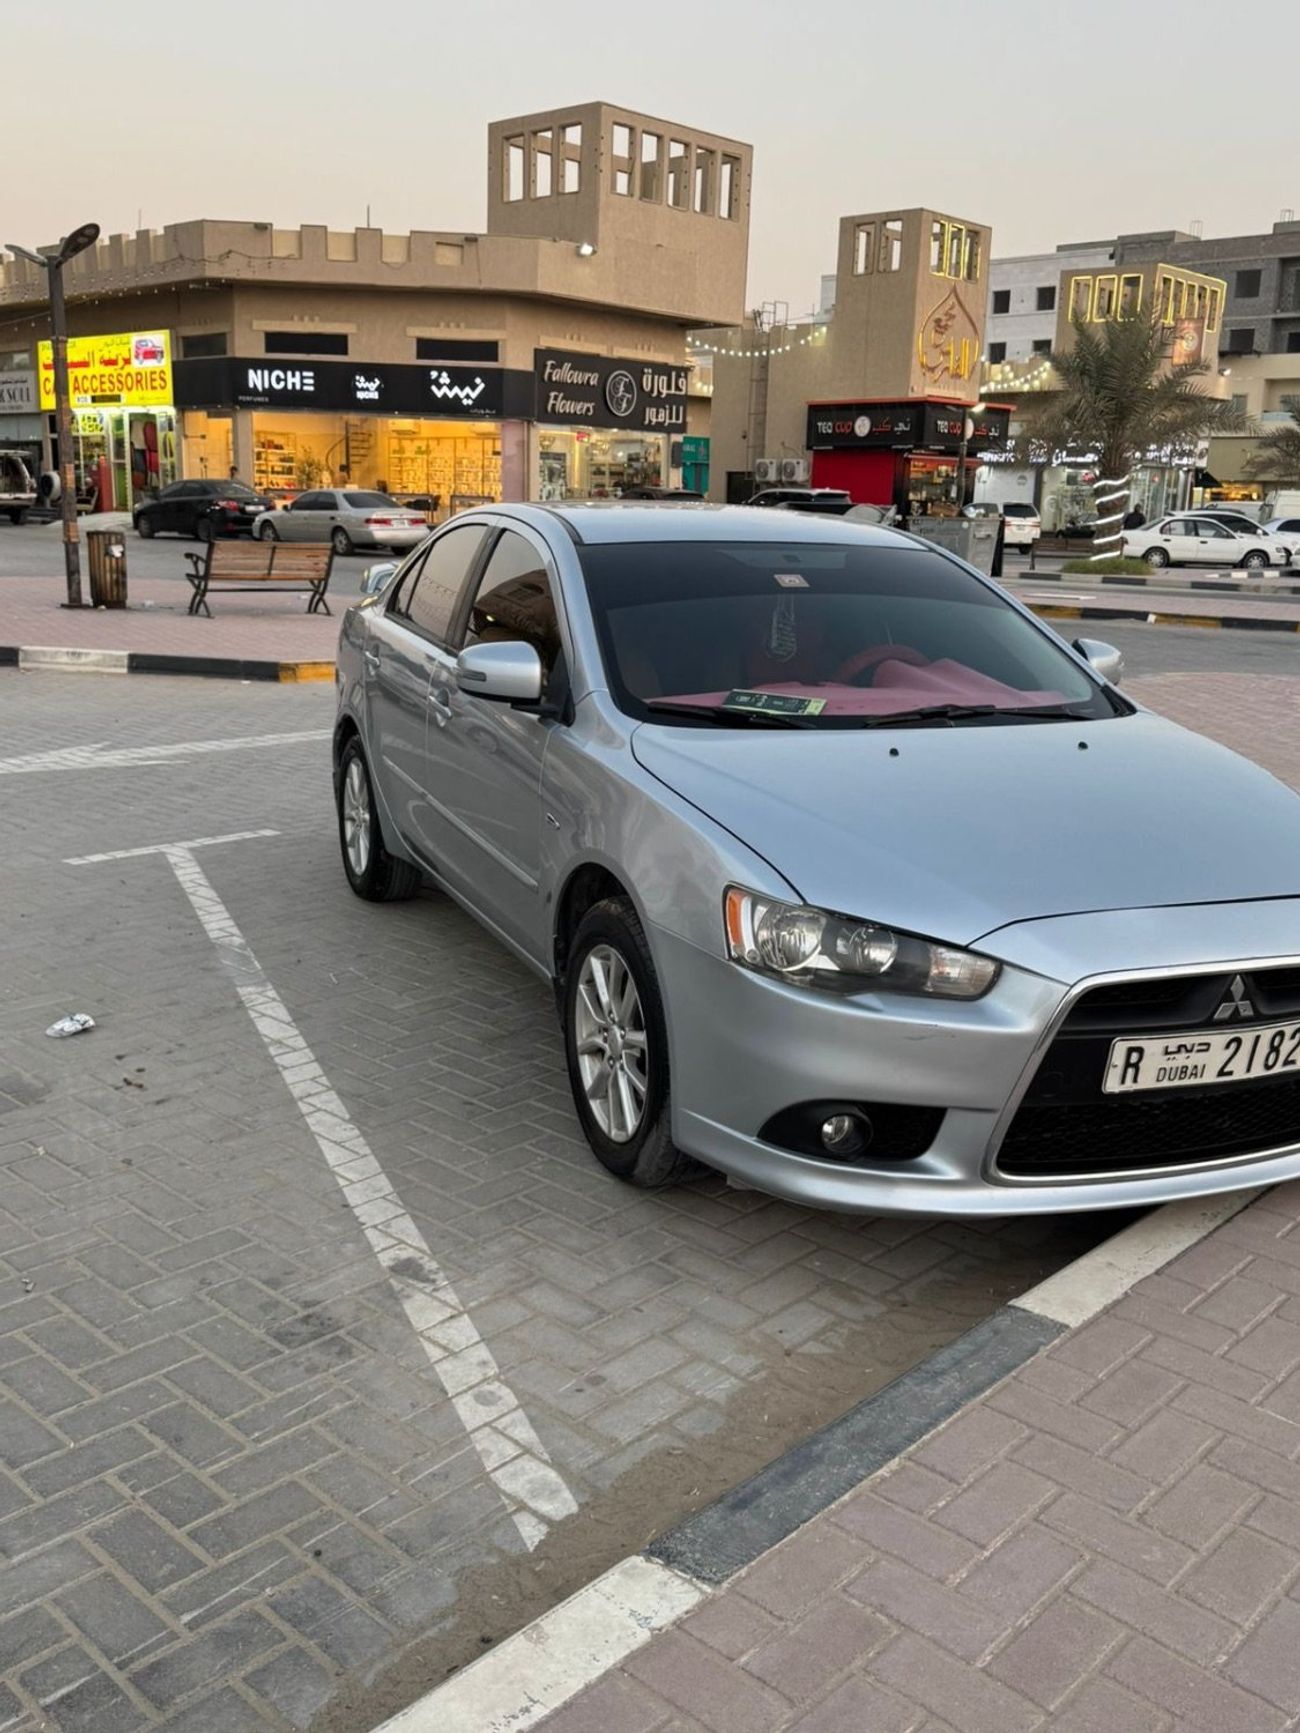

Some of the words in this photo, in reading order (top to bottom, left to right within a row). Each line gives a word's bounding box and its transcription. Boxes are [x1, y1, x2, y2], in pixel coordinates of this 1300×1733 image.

[73, 370, 167, 394] ACCESSORIES
[248, 369, 315, 392] NICHE
[544, 360, 599, 386] Fallowra
[642, 368, 687, 398] فلورة
[547, 391, 595, 416] Flowers
[644, 405, 684, 426] للزهور
[1121, 1047, 1145, 1084] R
[1216, 1027, 1300, 1078] 2182
[1163, 1042, 1211, 1061] دبي
[1156, 1064, 1206, 1082] DUBAI
